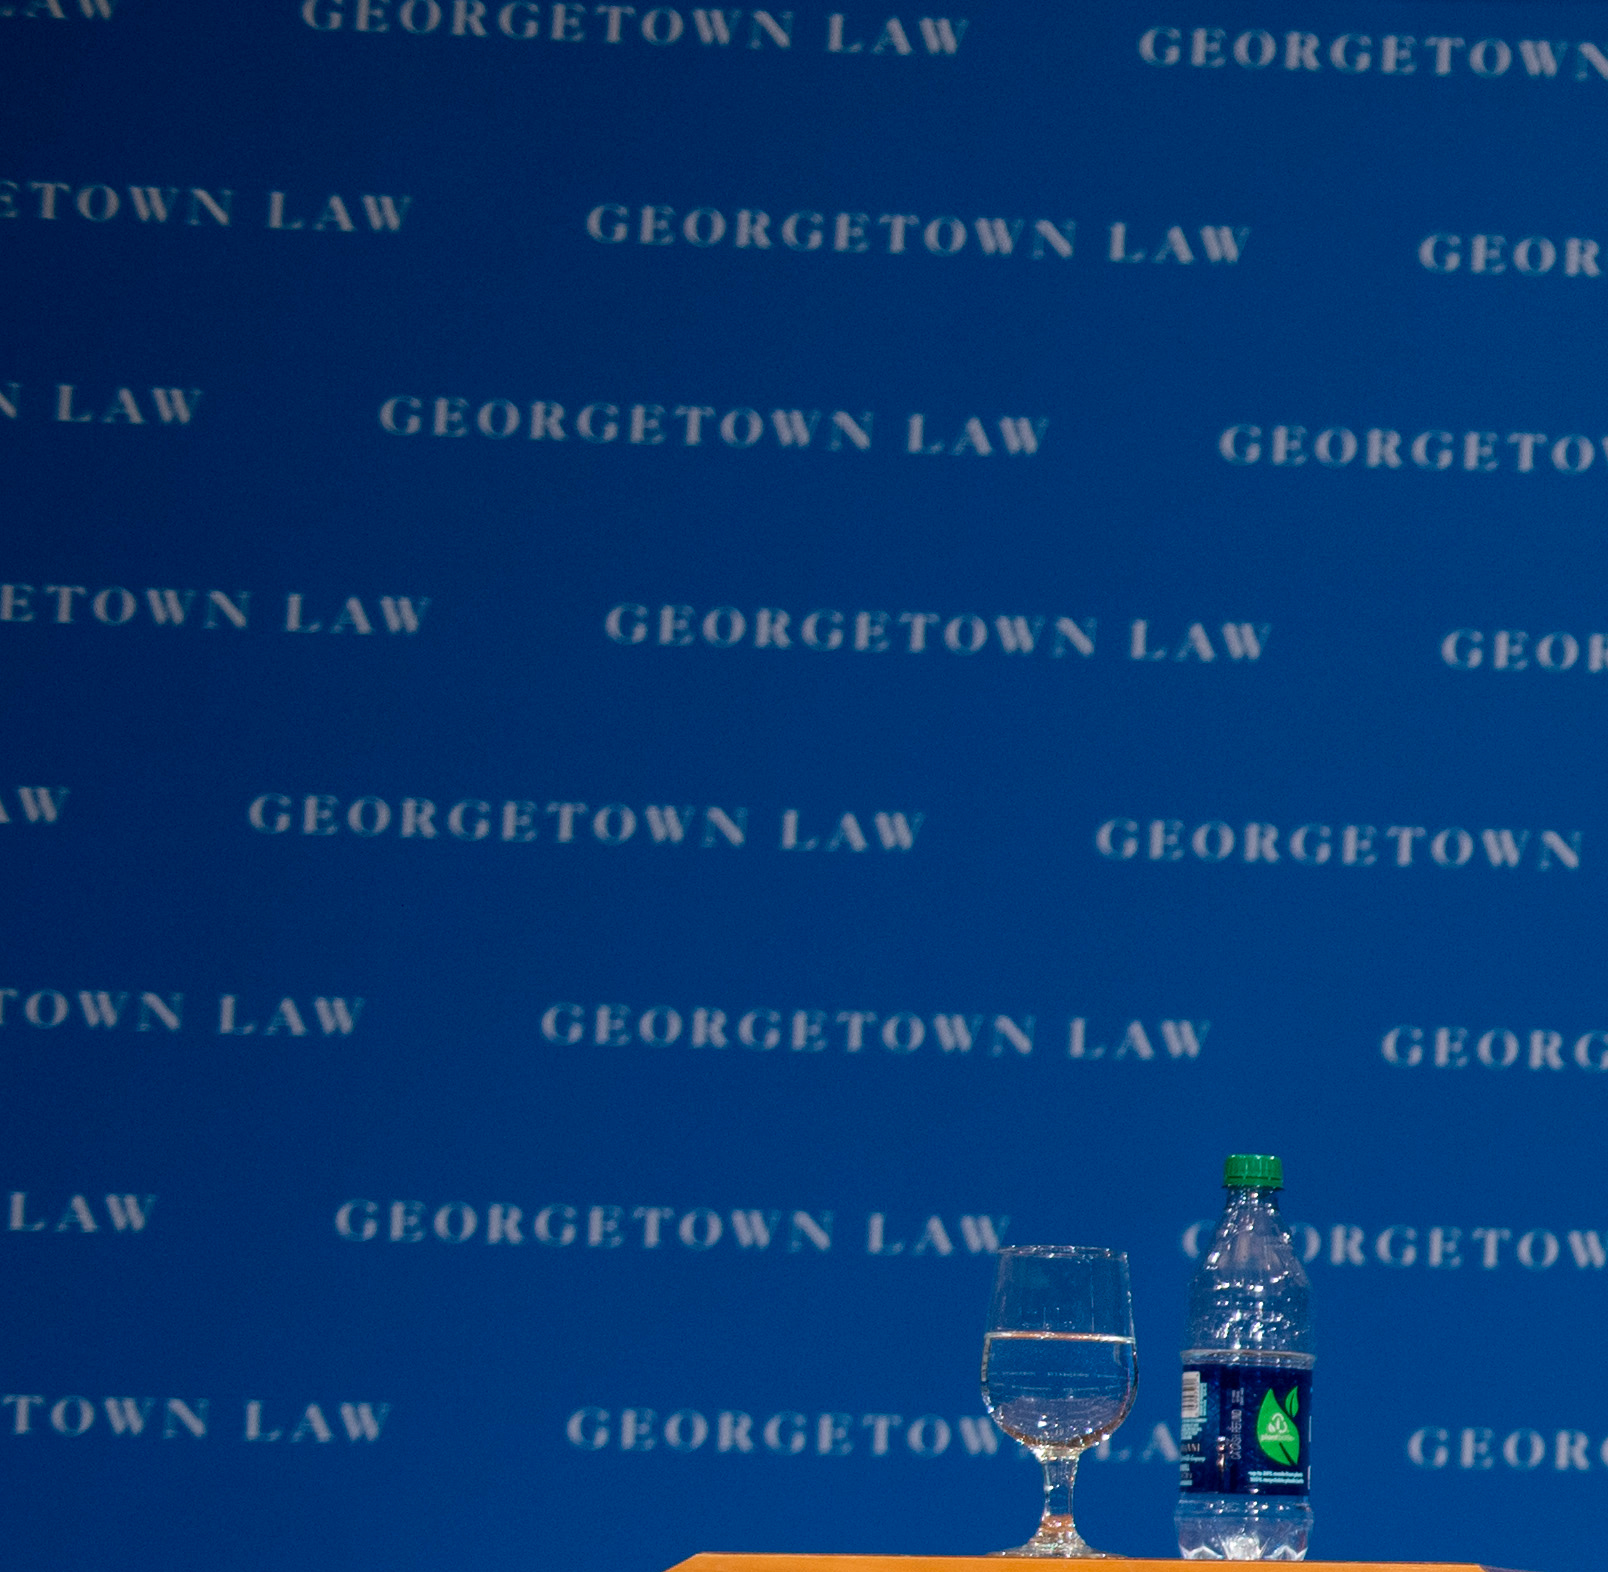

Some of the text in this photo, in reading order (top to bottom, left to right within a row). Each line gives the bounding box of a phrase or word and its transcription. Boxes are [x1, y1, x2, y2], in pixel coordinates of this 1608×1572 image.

[302, 0, 966, 55] GEORGETOWN LAW
[269, 191, 409, 232] LAW
[586, 205, 1247, 264] GEORGETOWN LAW
[57, 384, 200, 424] LAW
[379, 397, 1046, 456] GEORGETOWN LAW
[286, 593, 427, 634] LAW
[605, 605, 1270, 662] GEORGETOWN LAW
[249, 795, 922, 852] GEORGETOWN LAW
[1096, 820, 1579, 869] GEORGETOWN
[219, 995, 362, 1036] LAW
[541, 1005, 1208, 1060] GEORGETOWN LAW
[9, 1191, 154, 1233] LAW
[335, 1201, 1012, 1254] GEORGETOWN LAW
[245, 1400, 388, 1443] LAW
[566, 1404, 1010, 1455] GEORGETOW
